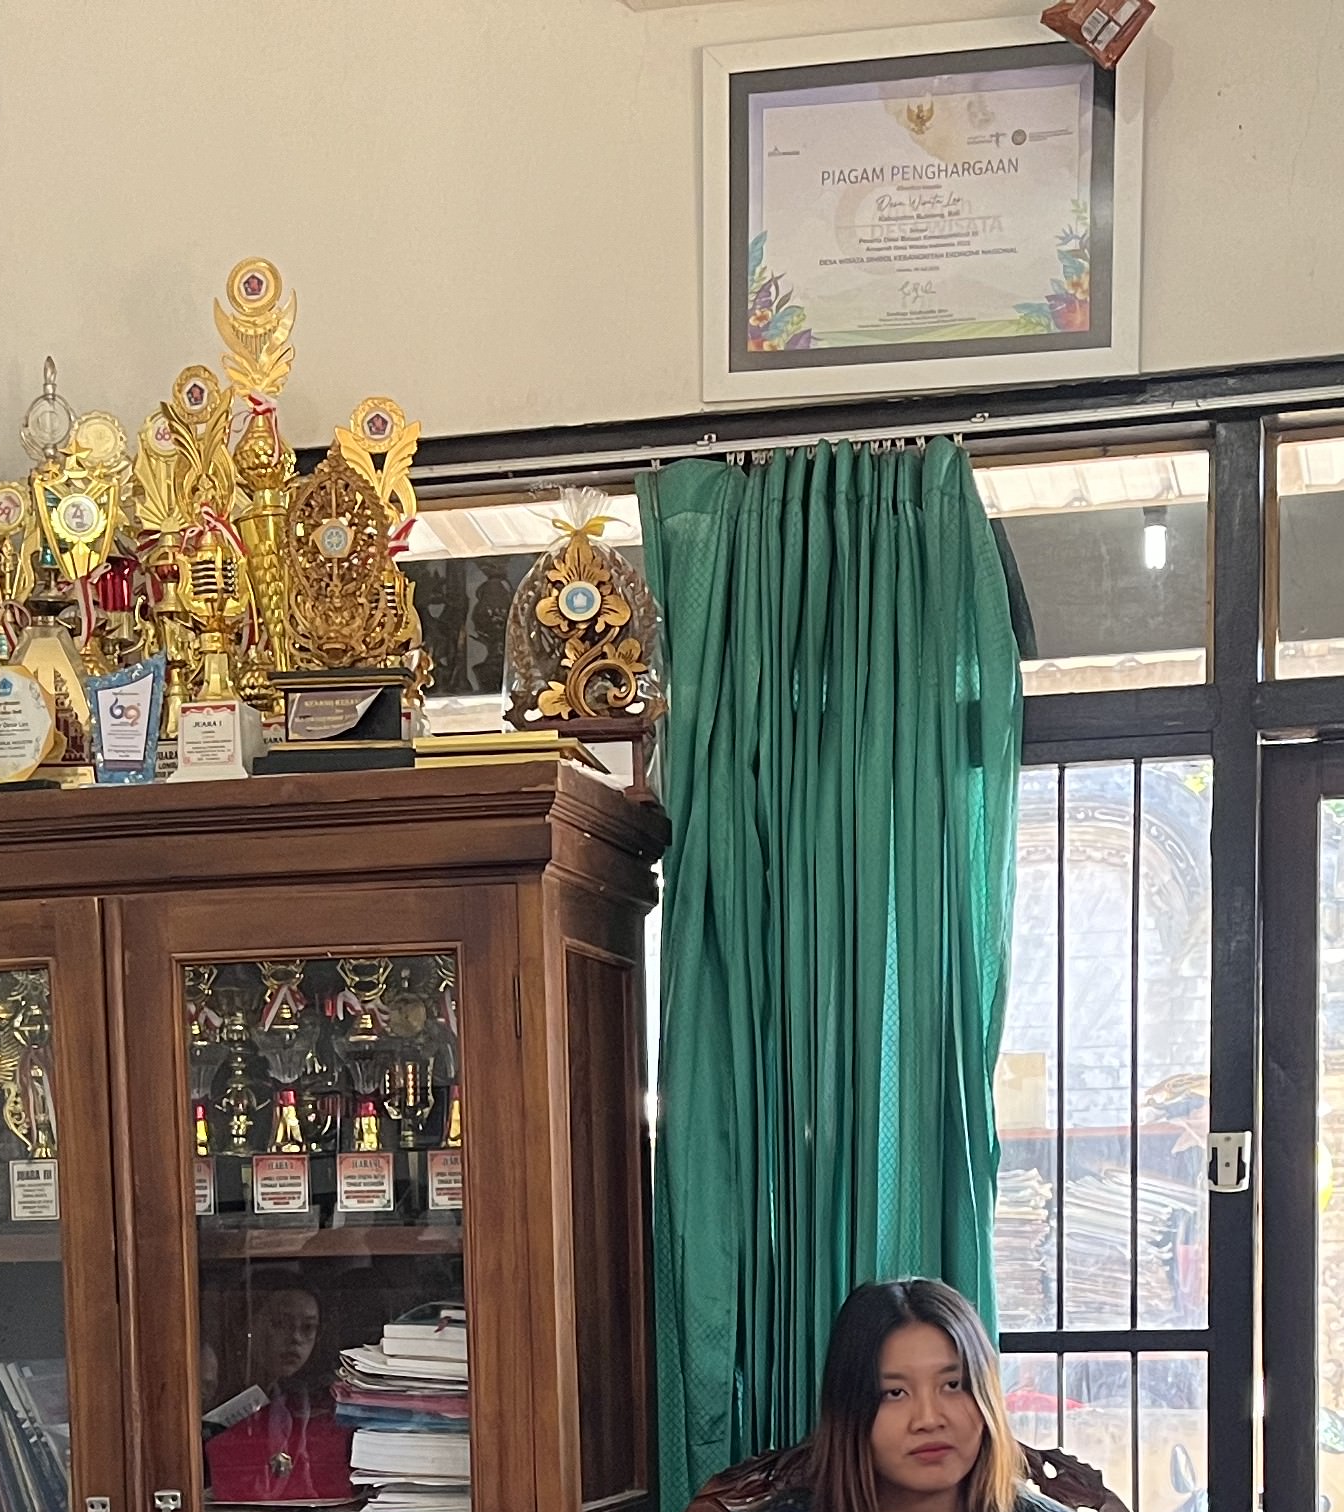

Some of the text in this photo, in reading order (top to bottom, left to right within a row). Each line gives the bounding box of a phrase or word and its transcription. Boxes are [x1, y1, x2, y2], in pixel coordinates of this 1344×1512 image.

[821, 158, 1019, 186] PIAGAM PENGHARGAAN
[262, 736, 283, 745] UARA
